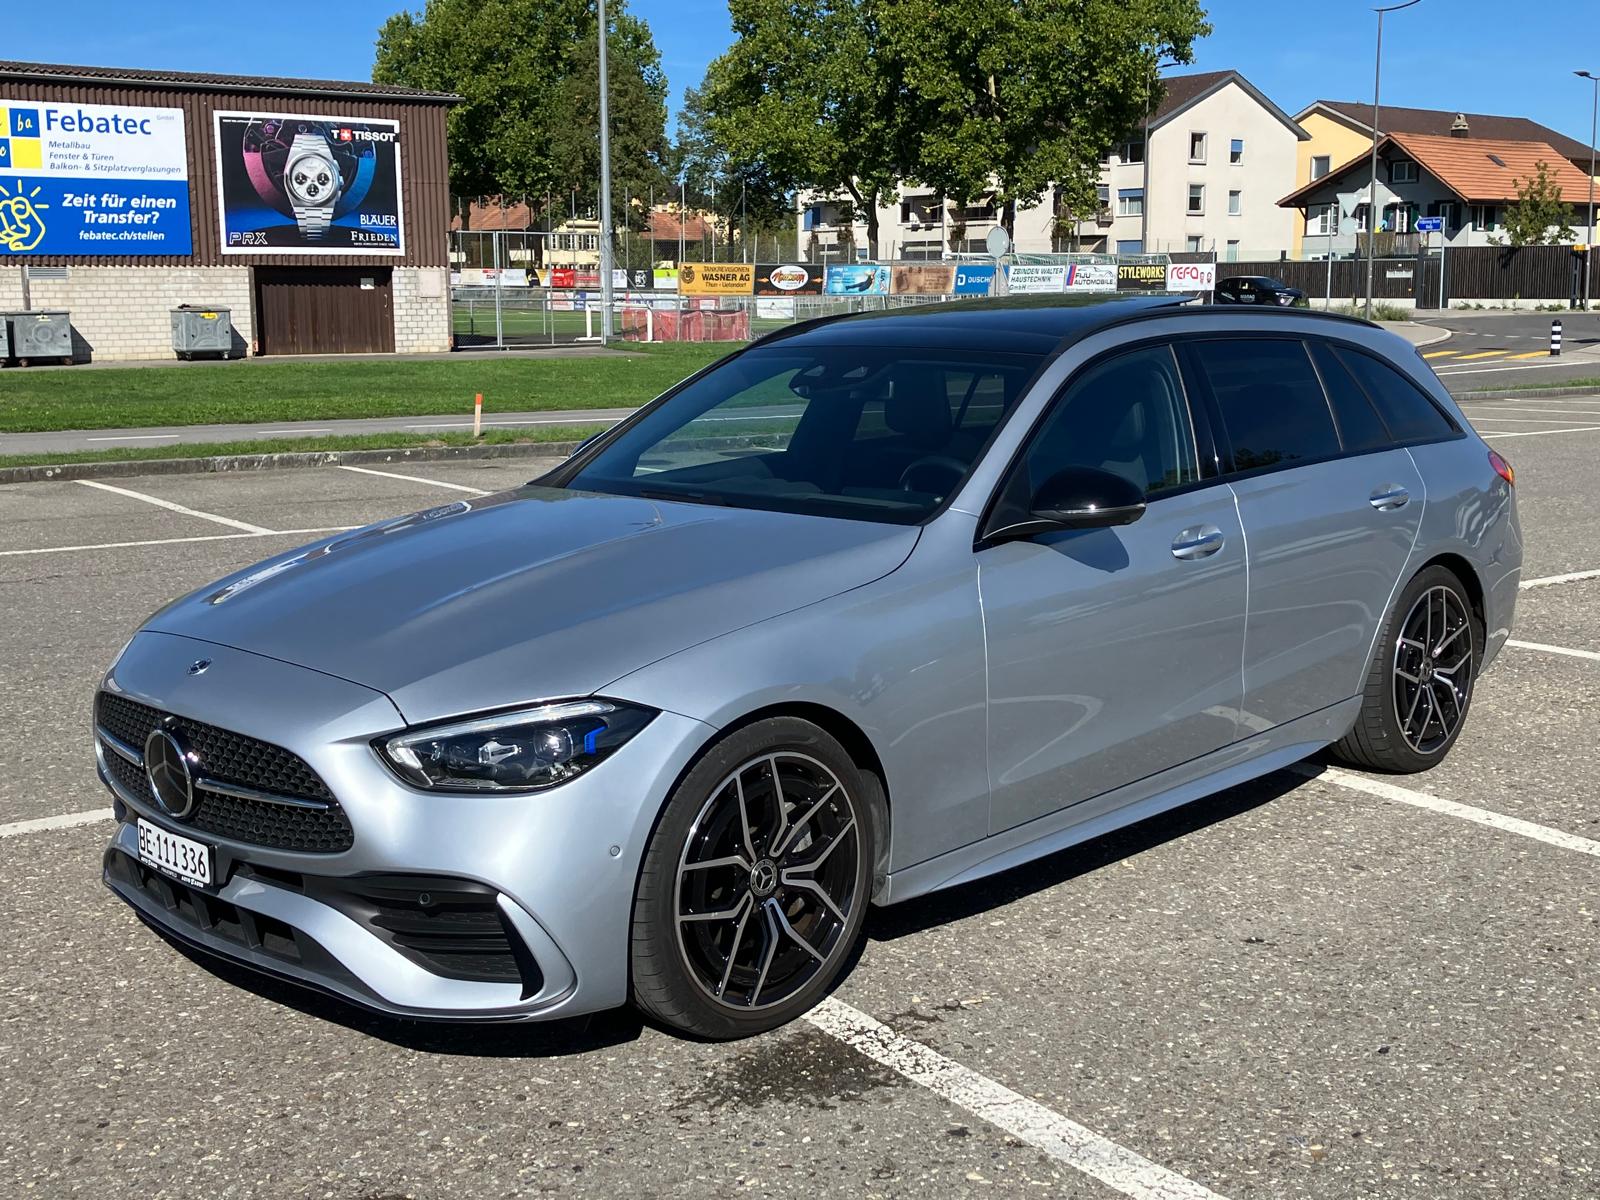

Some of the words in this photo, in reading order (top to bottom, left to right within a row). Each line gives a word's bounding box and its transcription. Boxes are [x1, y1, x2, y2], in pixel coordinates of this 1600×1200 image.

[46, 109, 151, 135] Febatec
[352, 130, 396, 142] TISSOT
[48, 141, 91, 149] Metallbau
[49, 152, 80, 160] Fenster
[91, 153, 114, 161] Türen
[50, 162, 82, 170] Balkon-
[84, 163, 91, 171] &
[93, 164, 181, 174] Sitzplatzverglasungen
[62, 193, 97, 207] Zeit
[100, 193, 127, 208] für
[130, 195, 177, 209] einen
[83, 210, 160, 225] Transfer?
[79, 230, 165, 241] febatec.ch/stellen
[229, 231, 268, 245] PRX
[702, 273, 737, 281] WASNER
[1041, 267, 1063, 275] WALTER
[1118, 266, 1165, 280] STYLEWORKS
